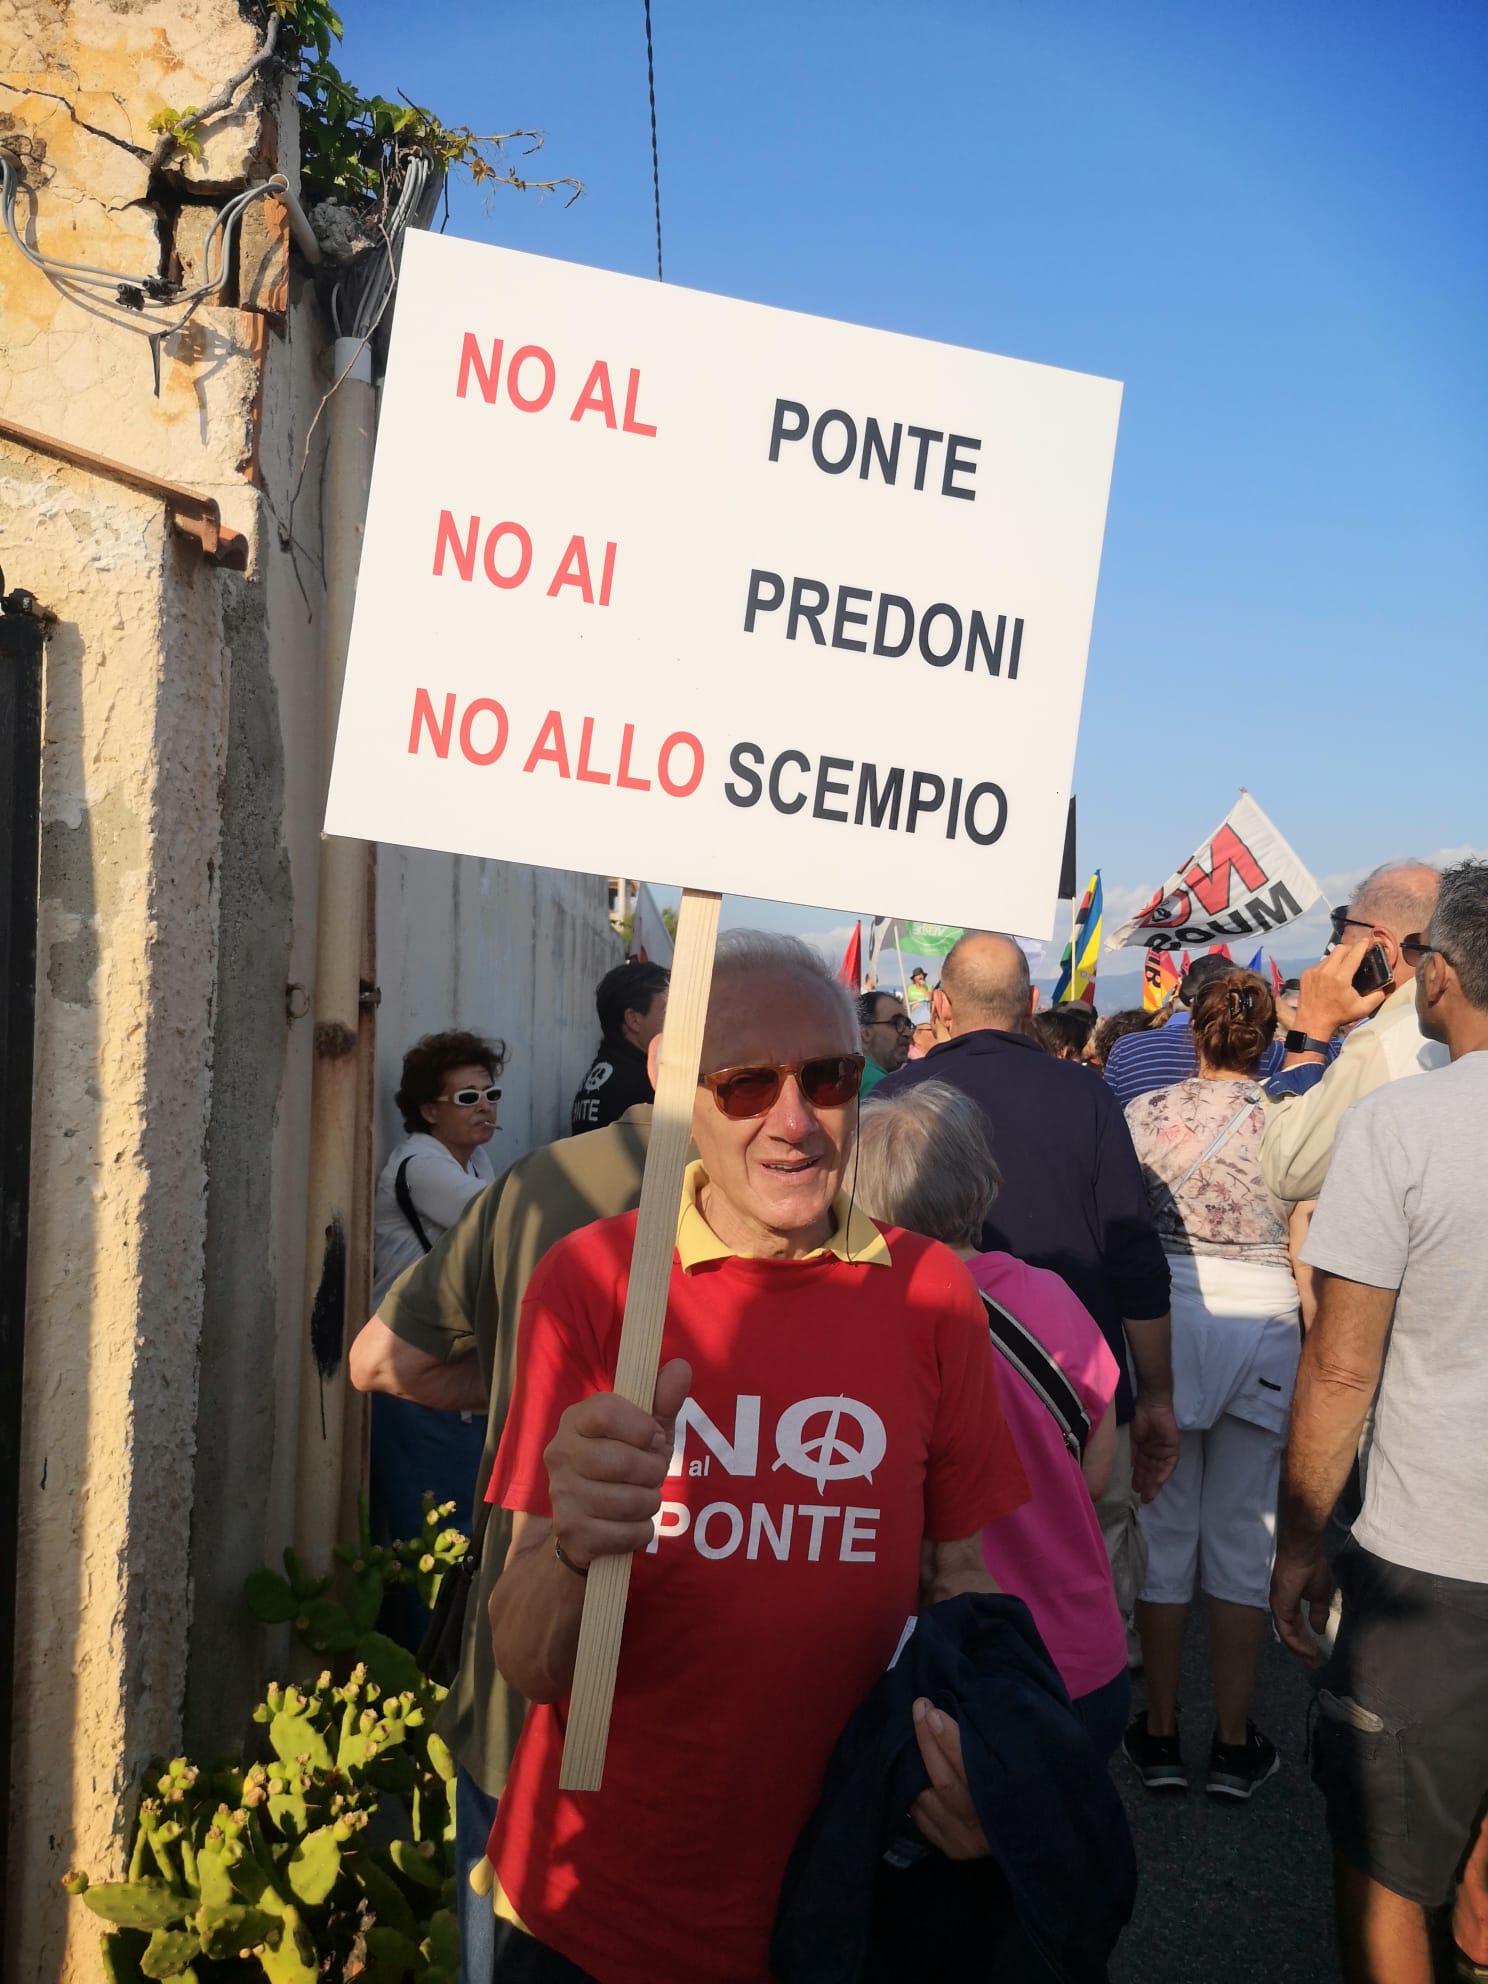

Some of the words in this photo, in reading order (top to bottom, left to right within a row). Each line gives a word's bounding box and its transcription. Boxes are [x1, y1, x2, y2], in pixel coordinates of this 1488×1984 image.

[457, 333, 555, 412] NO
[570, 361, 656, 437] AL
[769, 399, 981, 501] PONTE
[433, 510, 532, 589] NO
[547, 535, 616, 606] AI
[744, 569, 1024, 679] PREDONI
[408, 688, 508, 766] NO
[523, 711, 704, 797] ALLO
[725, 742, 1007, 845] SCEMPIO
[666, 1393, 887, 1496] NO
[688, 1455, 710, 1477] al
[645, 1501, 881, 1562] PONTE
